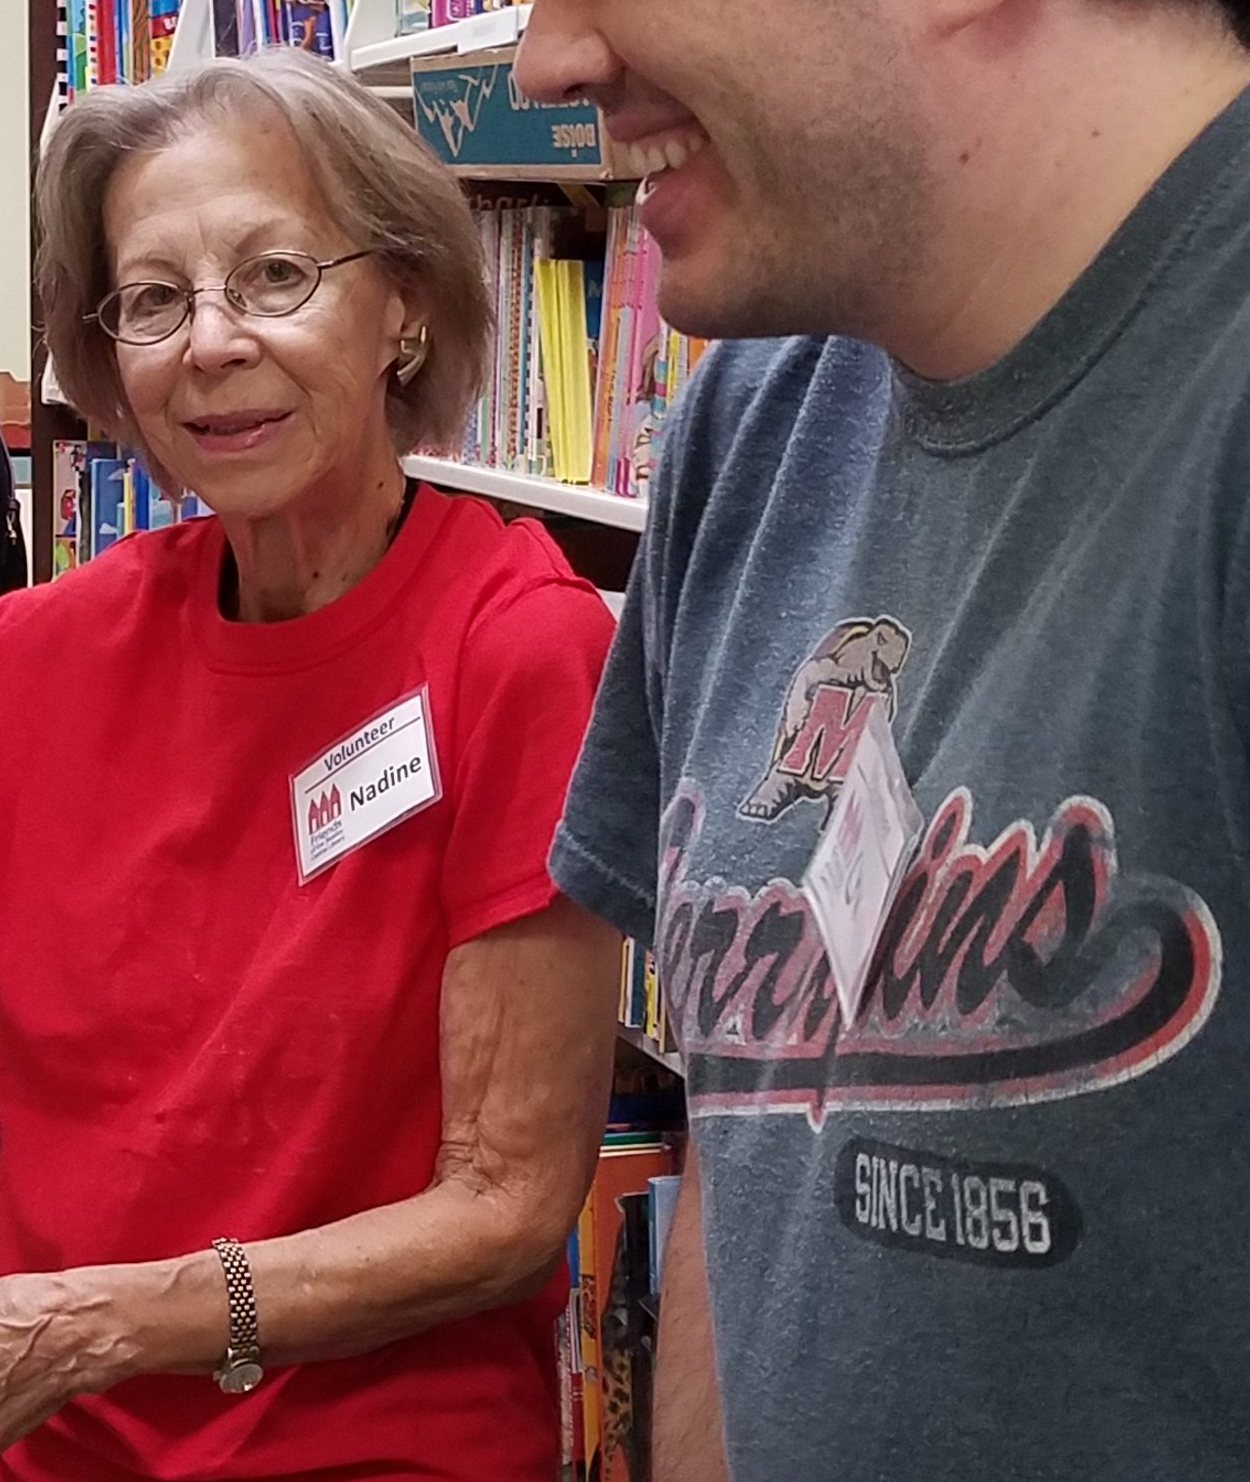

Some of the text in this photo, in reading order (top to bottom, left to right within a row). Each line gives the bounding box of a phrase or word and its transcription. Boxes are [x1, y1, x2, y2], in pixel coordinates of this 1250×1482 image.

[323, 717, 395, 772] Volunteer
[349, 756, 423, 812] Nadine
[855, 1152, 1051, 1255] SINCE 1856
